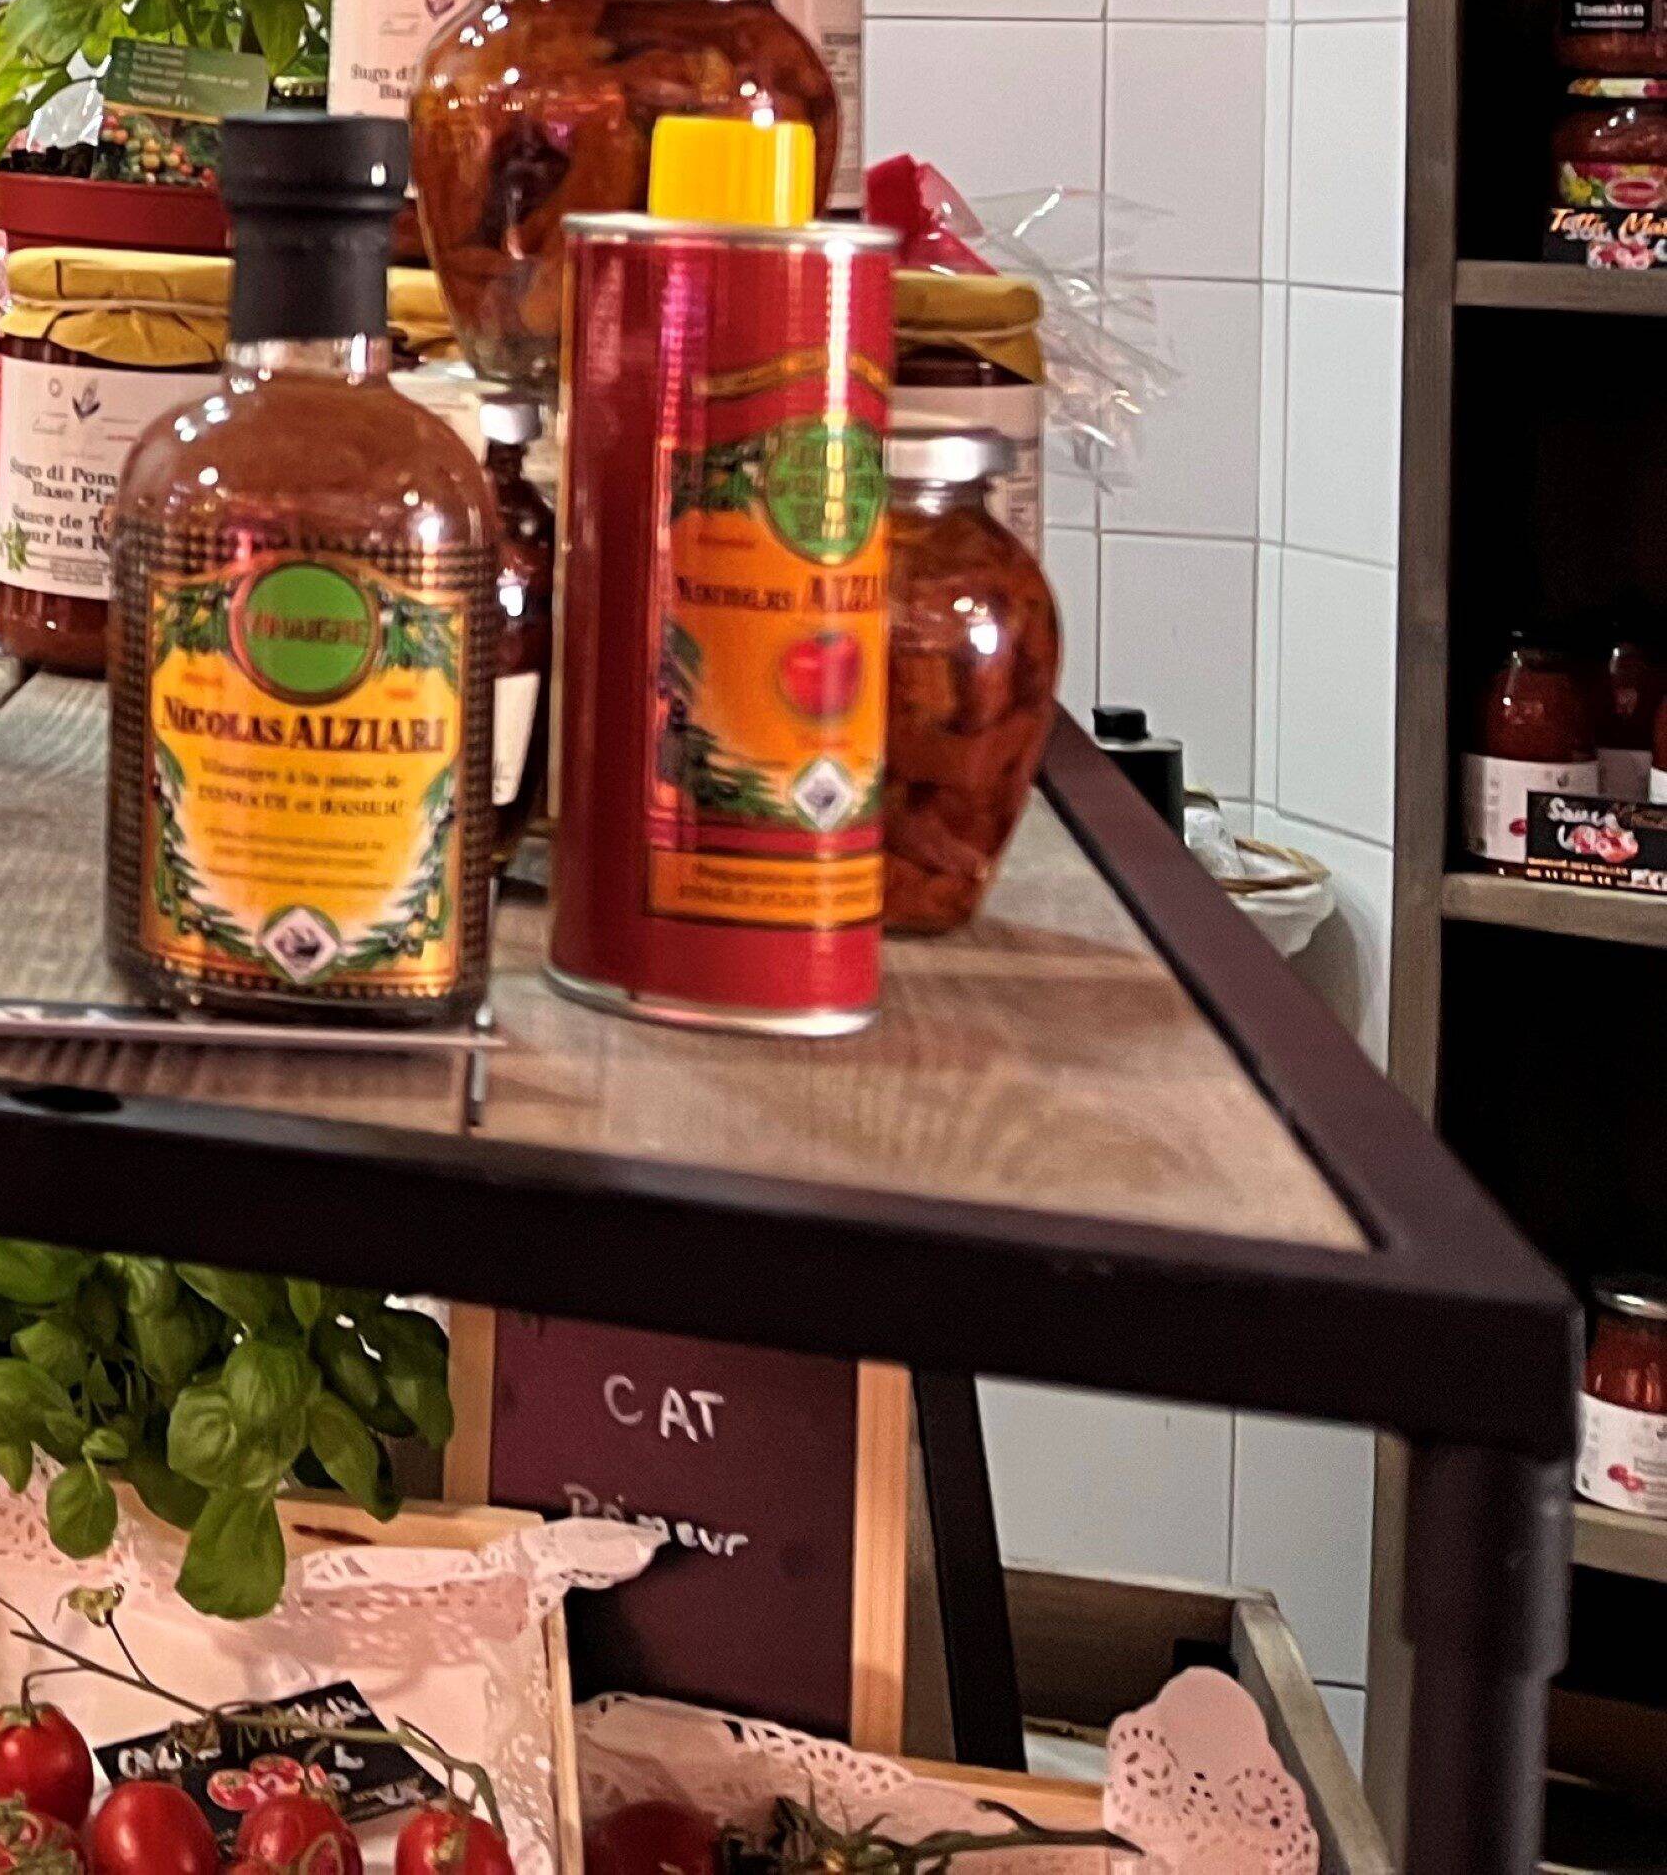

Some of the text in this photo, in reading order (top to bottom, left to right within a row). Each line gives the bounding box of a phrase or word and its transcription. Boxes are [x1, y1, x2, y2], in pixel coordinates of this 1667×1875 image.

[46, 464, 64, 481] di
[71, 466, 117, 487] Pom
[603, 1374, 724, 1442] CAT
